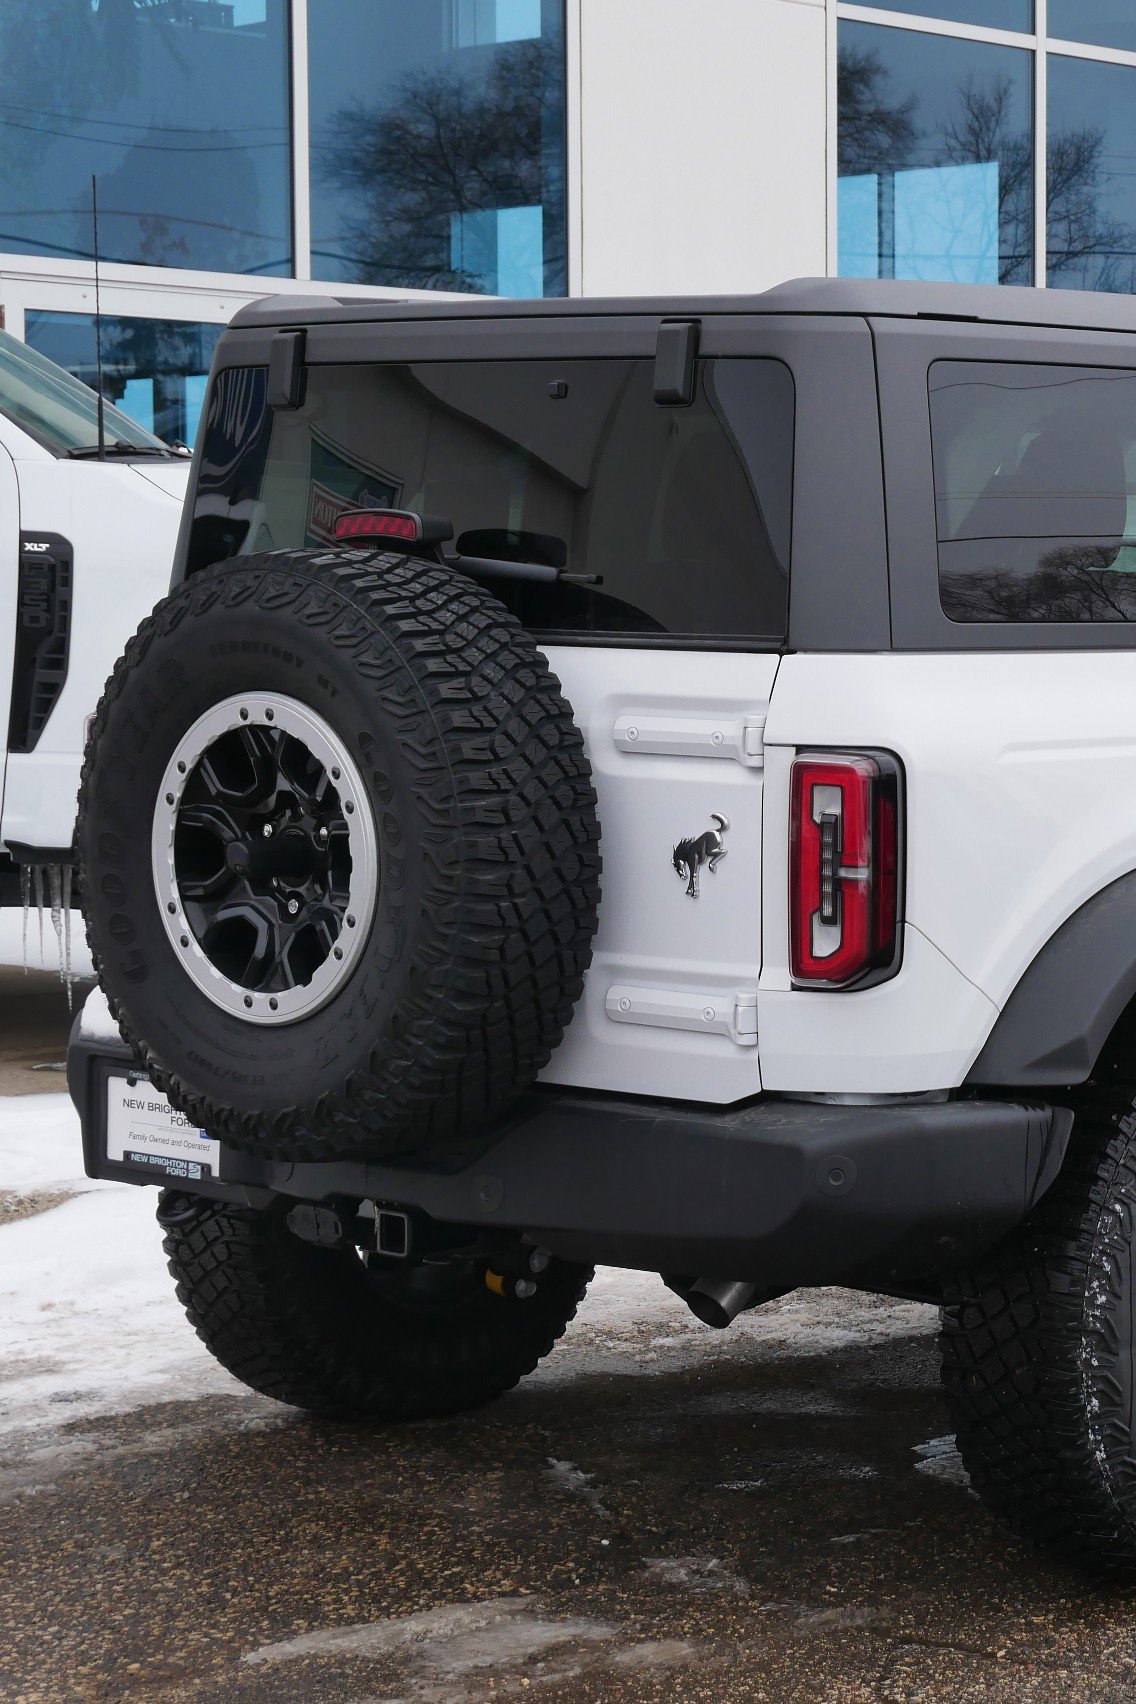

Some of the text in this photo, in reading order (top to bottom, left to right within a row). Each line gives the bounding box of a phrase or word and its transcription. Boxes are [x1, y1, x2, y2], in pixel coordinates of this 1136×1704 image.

[24, 542, 50, 551] XLT
[122, 1098, 145, 1110] NEW
[128, 1131, 149, 1144] Family
[149, 1134, 170, 1145] Owned
[170, 1138, 182, 1147] and
[183, 1140, 211, 1152] Operated
[131, 1152, 188, 1170] NEW BRIGHTON
[166, 1166, 188, 1177] FORD
